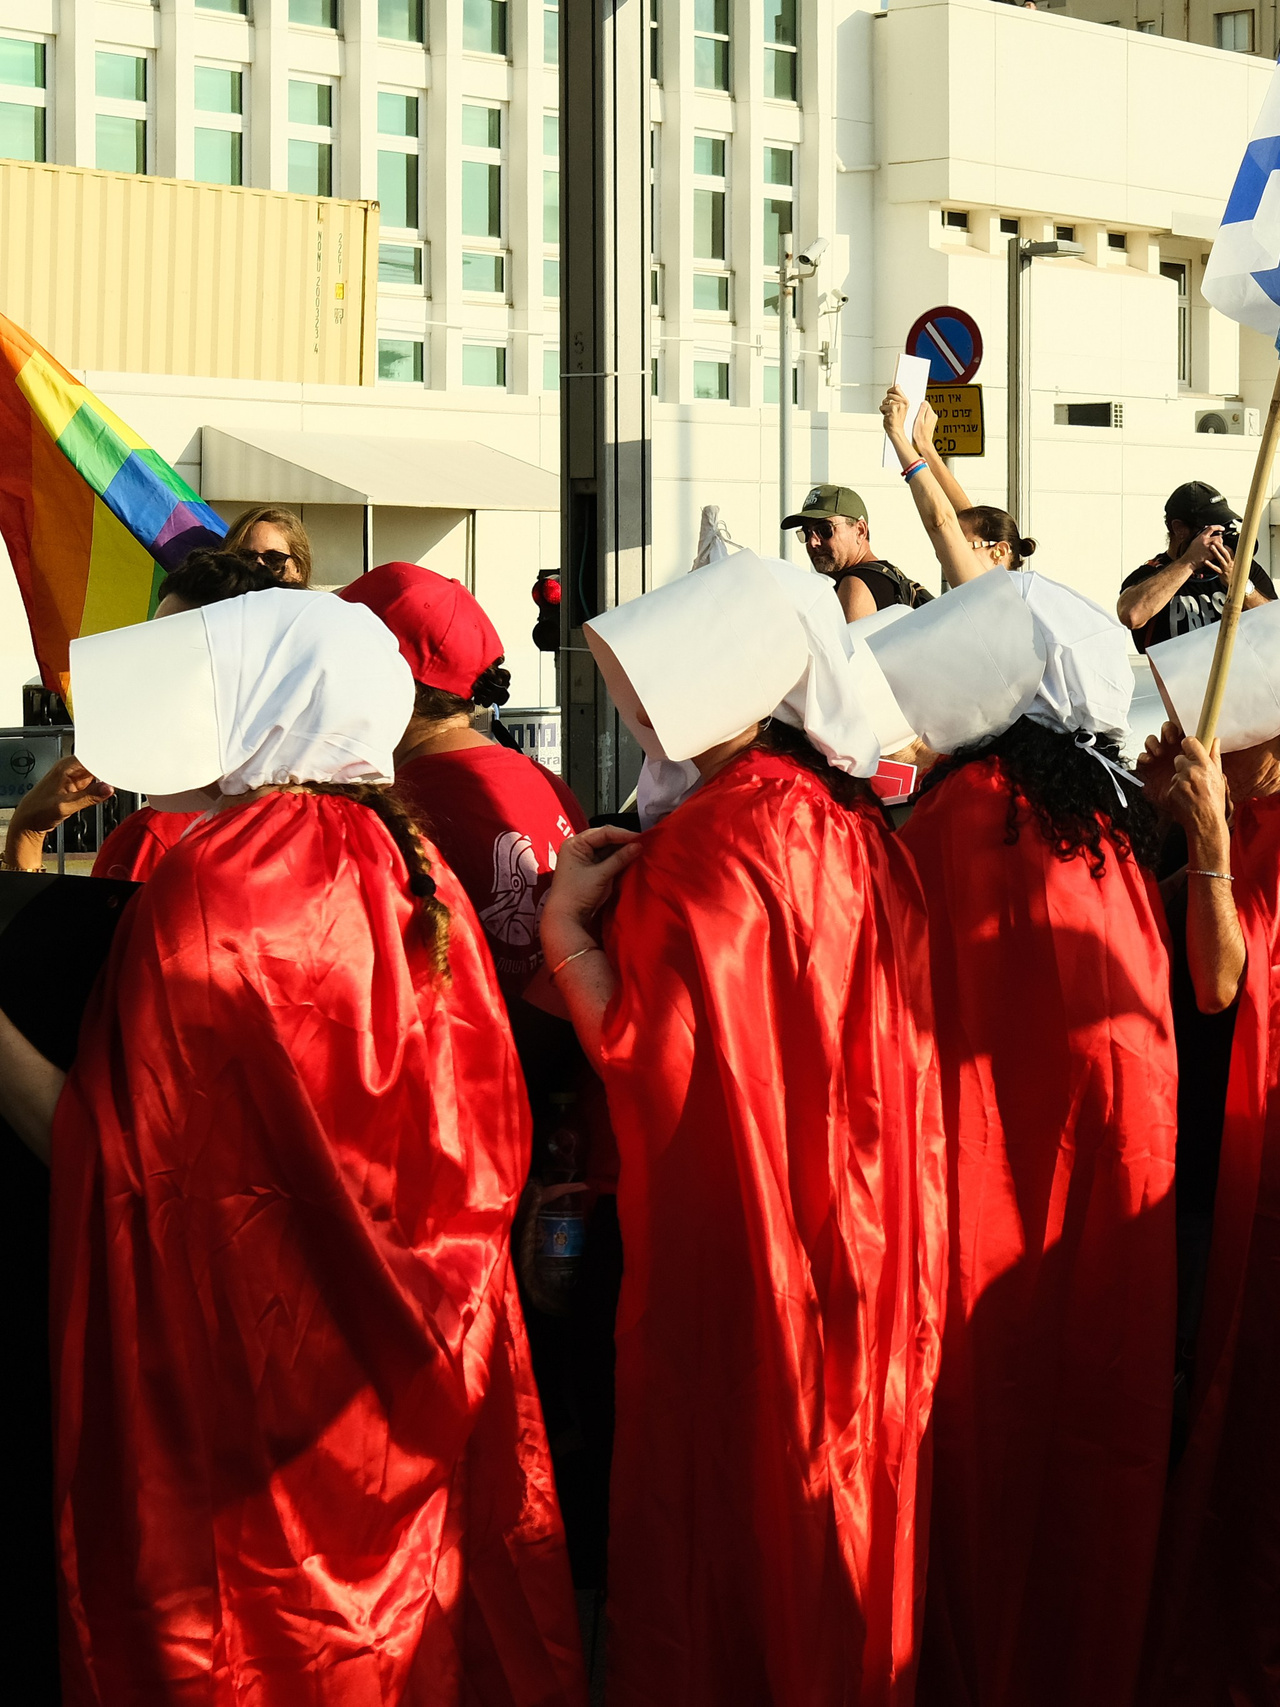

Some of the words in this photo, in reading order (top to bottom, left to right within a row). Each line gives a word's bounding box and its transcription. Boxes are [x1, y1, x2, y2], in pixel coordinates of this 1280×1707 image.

[948, 394, 962, 404] אין
[952, 408, 972, 418] פרט
[943, 424, 978, 434] שגרירות
[1170, 591, 1227, 638] PRES
